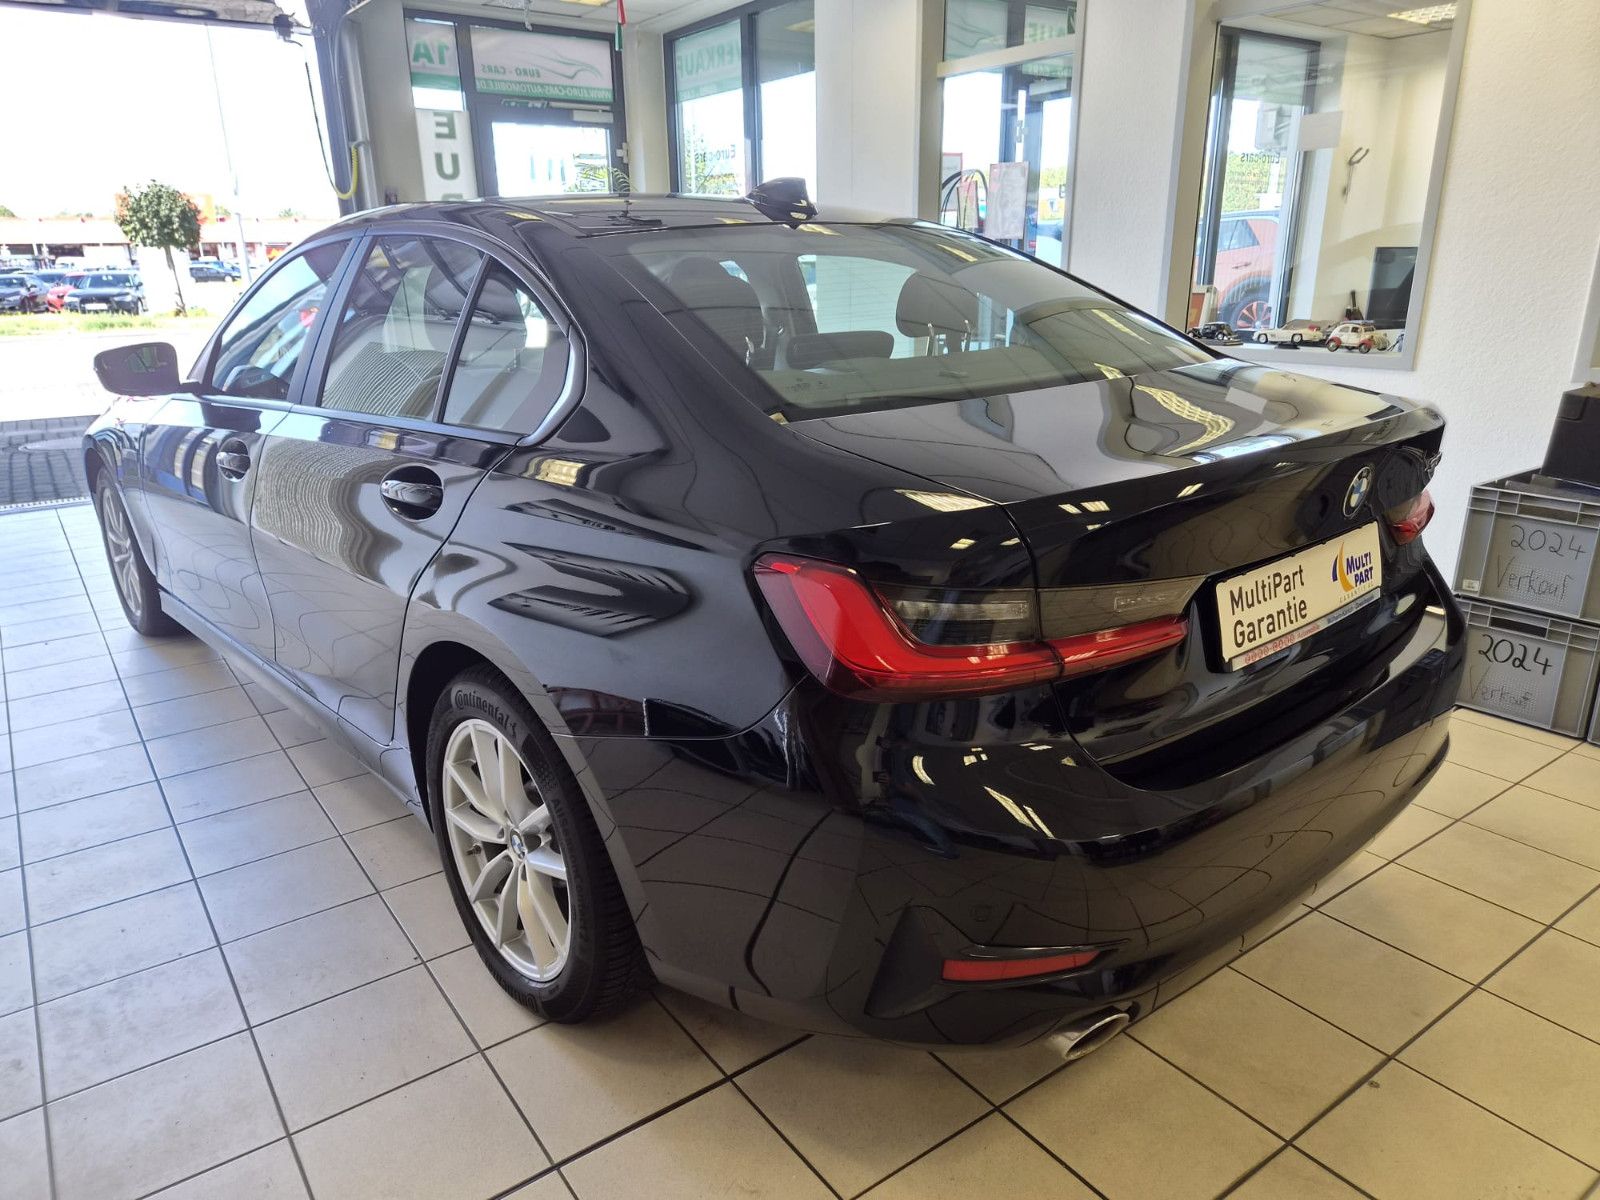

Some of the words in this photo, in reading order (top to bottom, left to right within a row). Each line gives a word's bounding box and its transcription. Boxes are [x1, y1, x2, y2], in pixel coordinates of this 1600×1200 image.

[1510, 524, 1587, 560] 2024
[1346, 551, 1372, 576] MULTI
[1354, 566, 1374, 588] PART
[1229, 564, 1305, 616] MultiPart
[1233, 596, 1308, 648] Garantie
[1478, 633, 1552, 676] 2024
[455, 689, 510, 730] Continental
